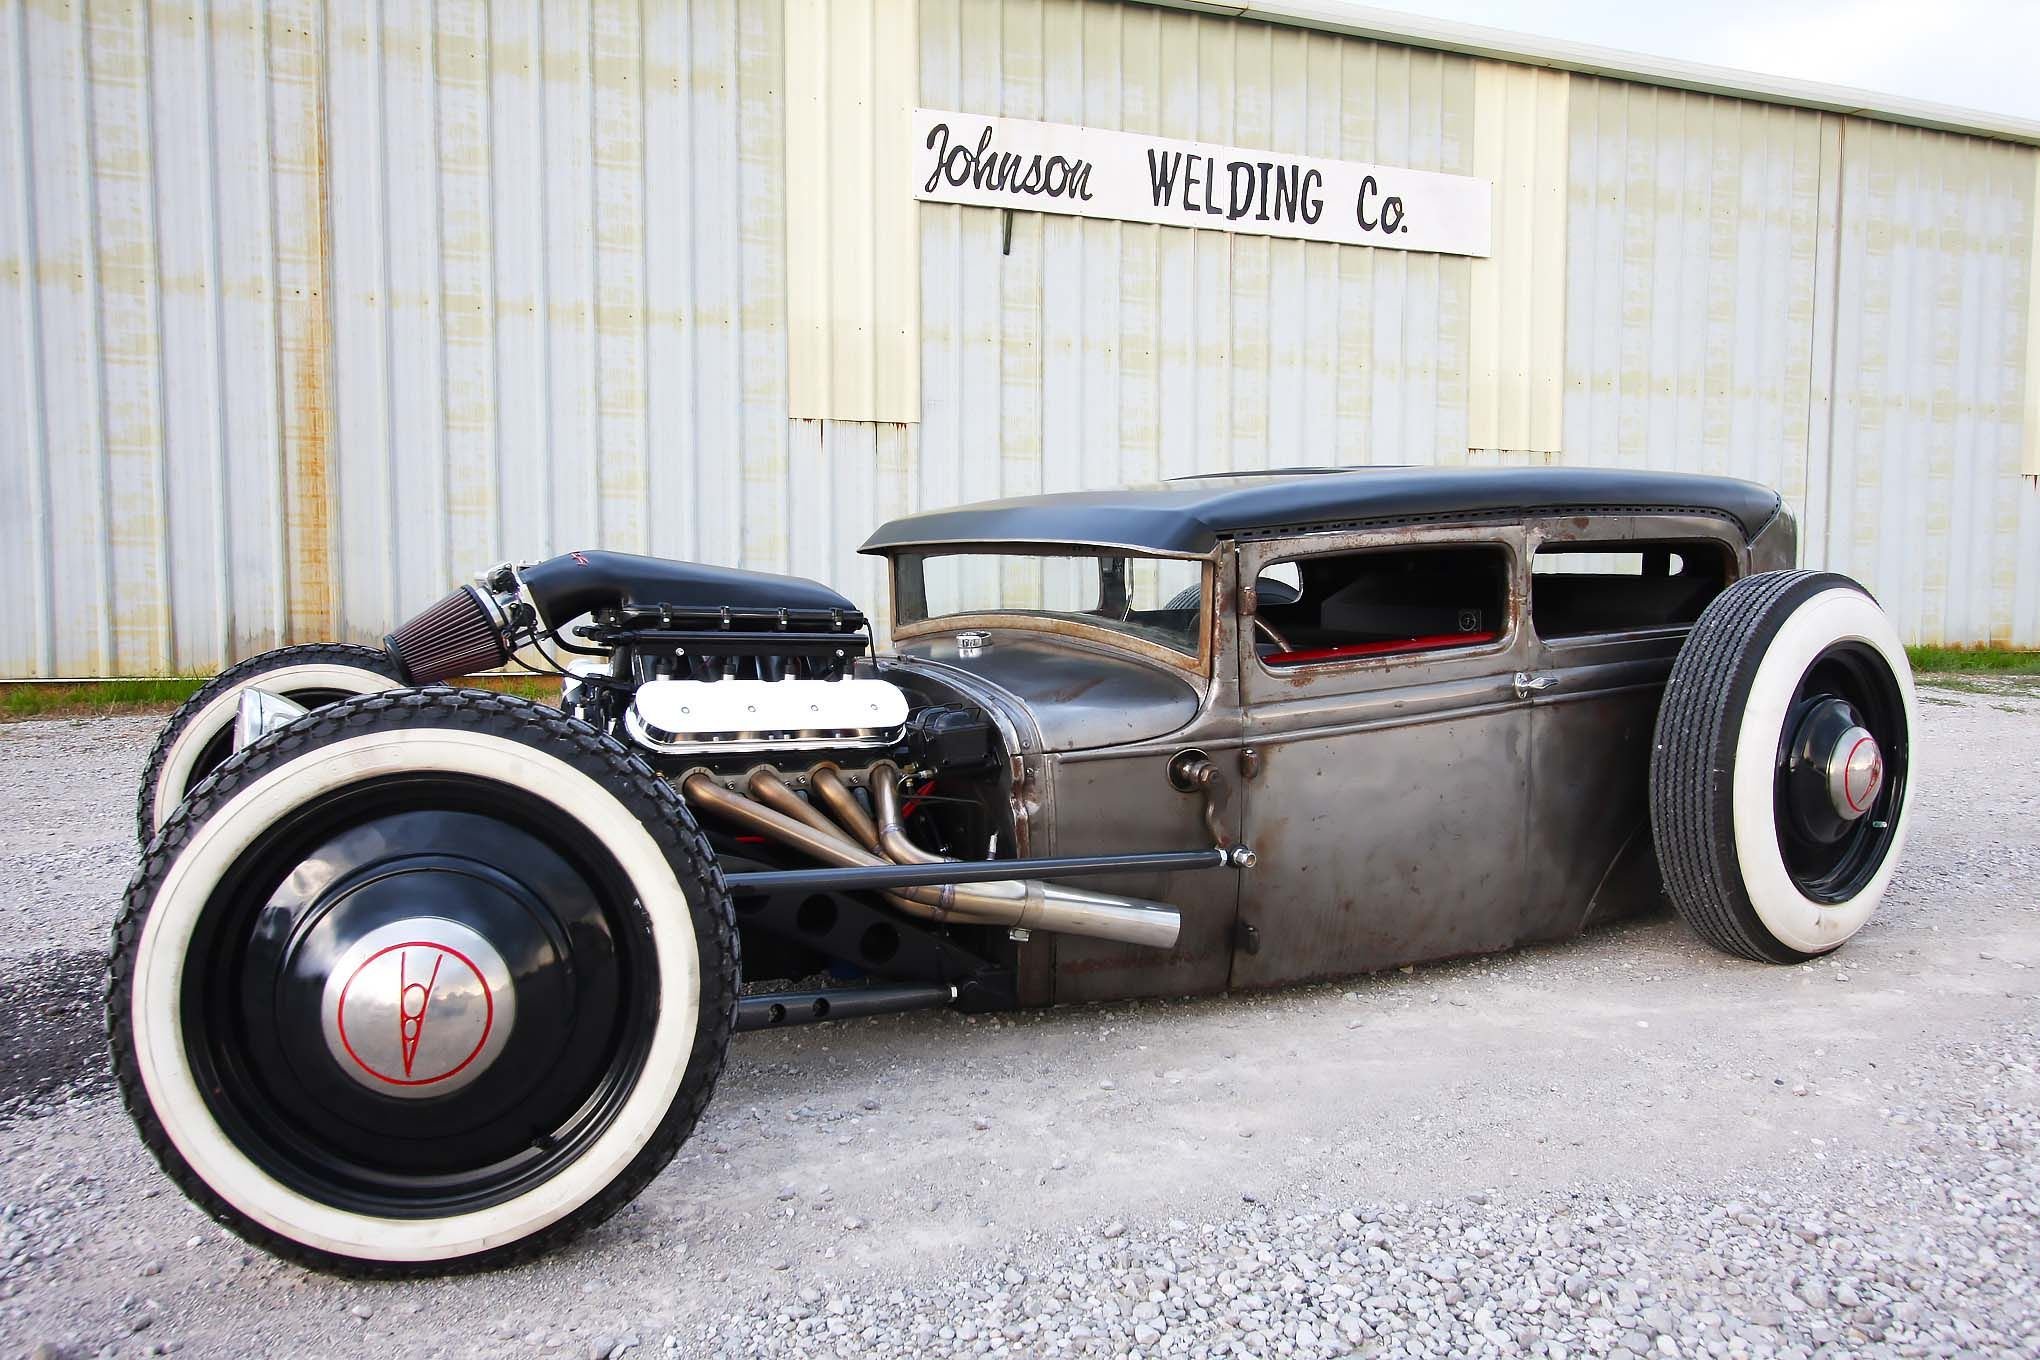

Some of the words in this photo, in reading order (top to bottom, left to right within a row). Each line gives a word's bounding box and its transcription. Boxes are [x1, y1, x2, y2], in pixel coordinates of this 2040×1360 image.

[925, 123, 1093, 201] Johnson
[1148, 149, 1323, 225] WELDING
[1357, 175, 1408, 234] Co.
